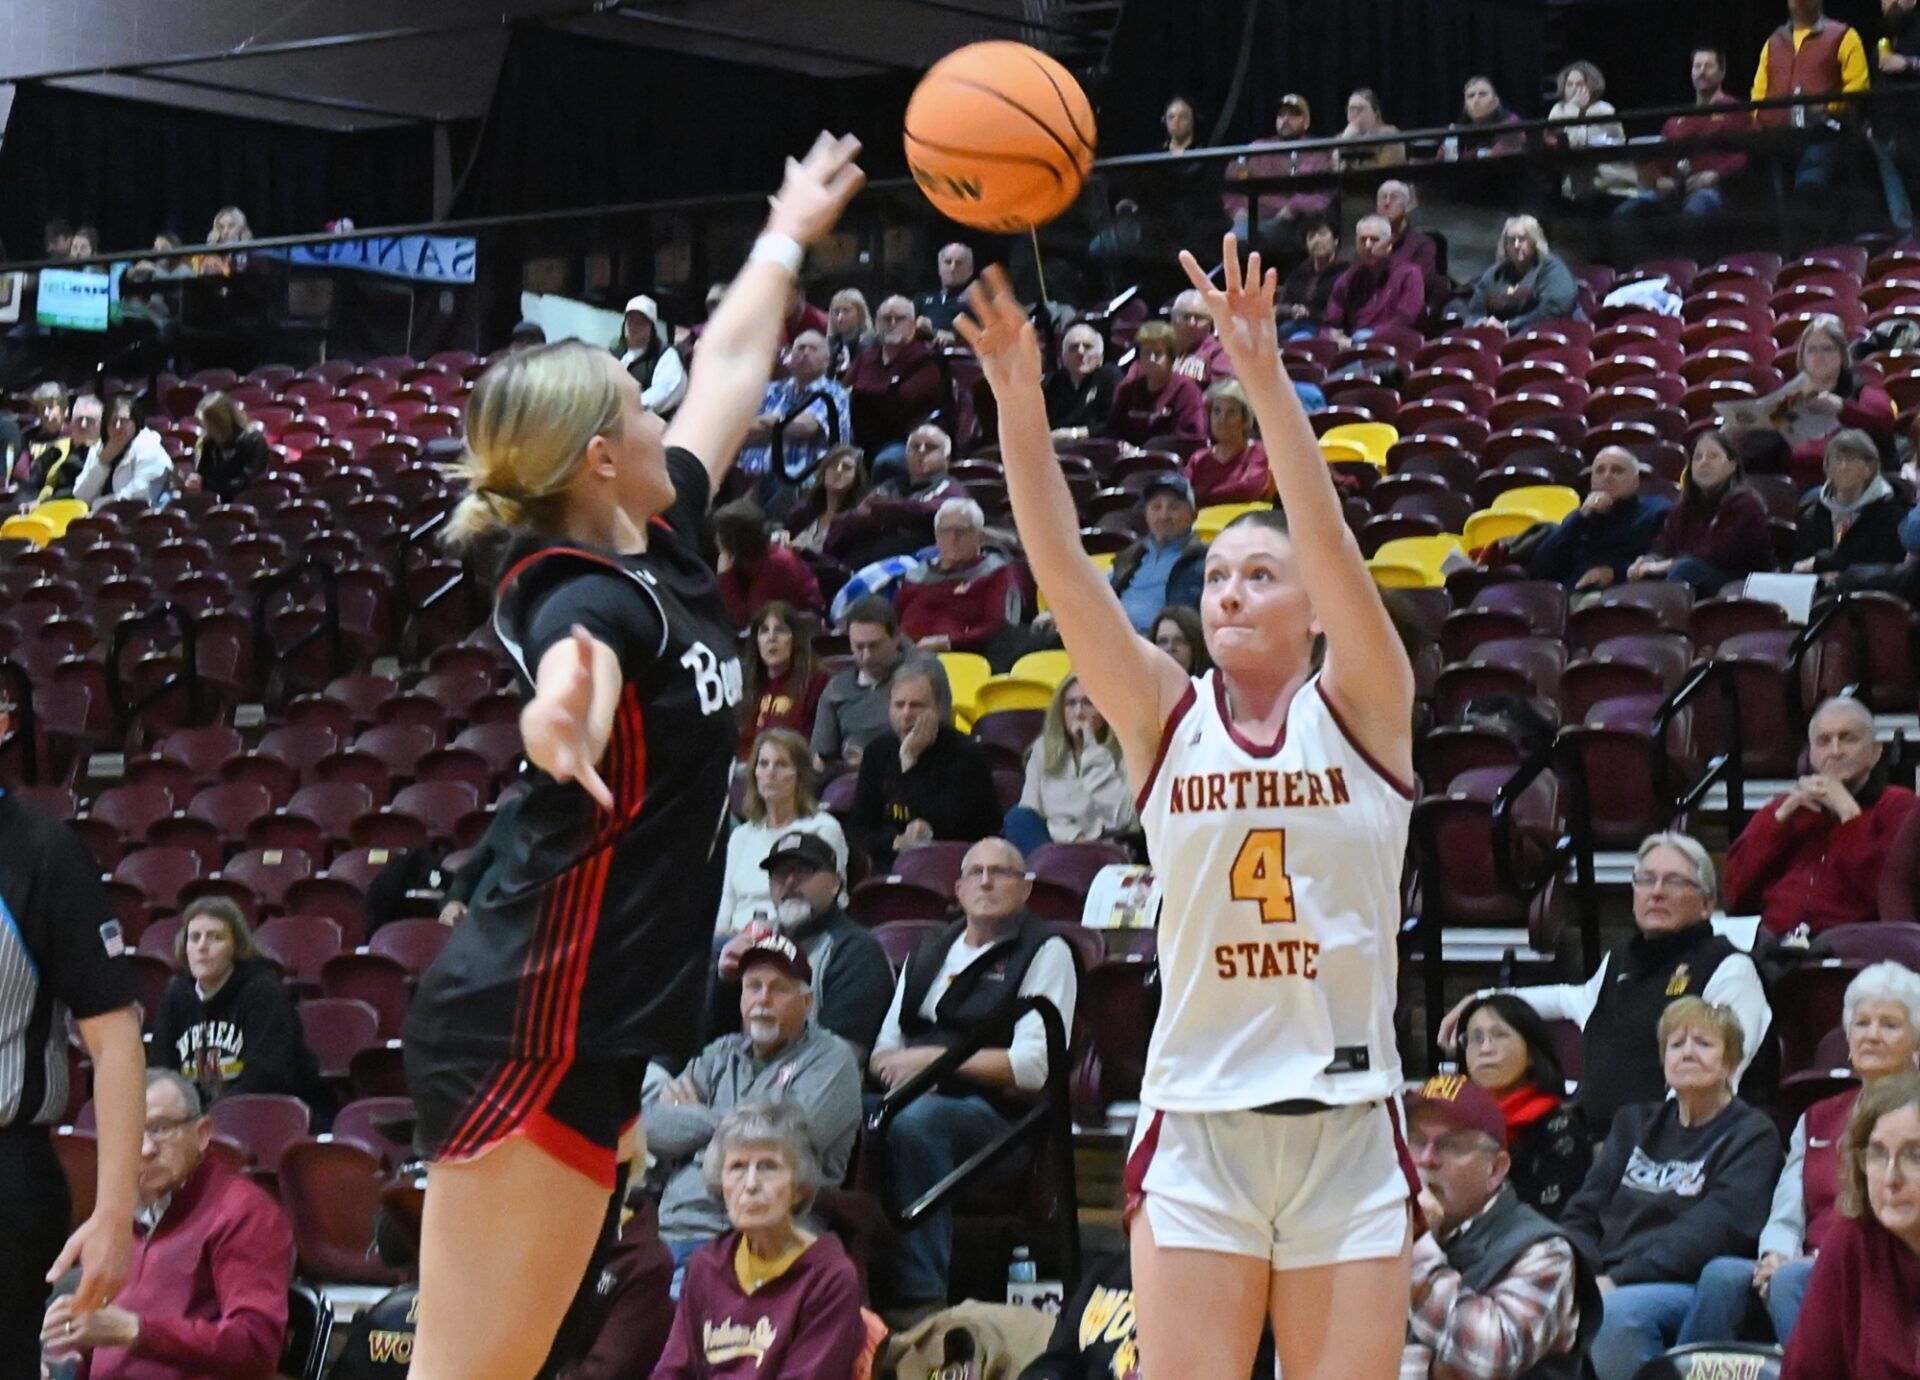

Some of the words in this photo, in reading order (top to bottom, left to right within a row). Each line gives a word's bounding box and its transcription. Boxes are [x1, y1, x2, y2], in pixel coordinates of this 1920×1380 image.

[1169, 767, 1351, 815] NORTHERN
[1229, 828, 1297, 924] 4
[1214, 940, 1320, 980] STATE
[1686, 1352, 1766, 1380] NSU
